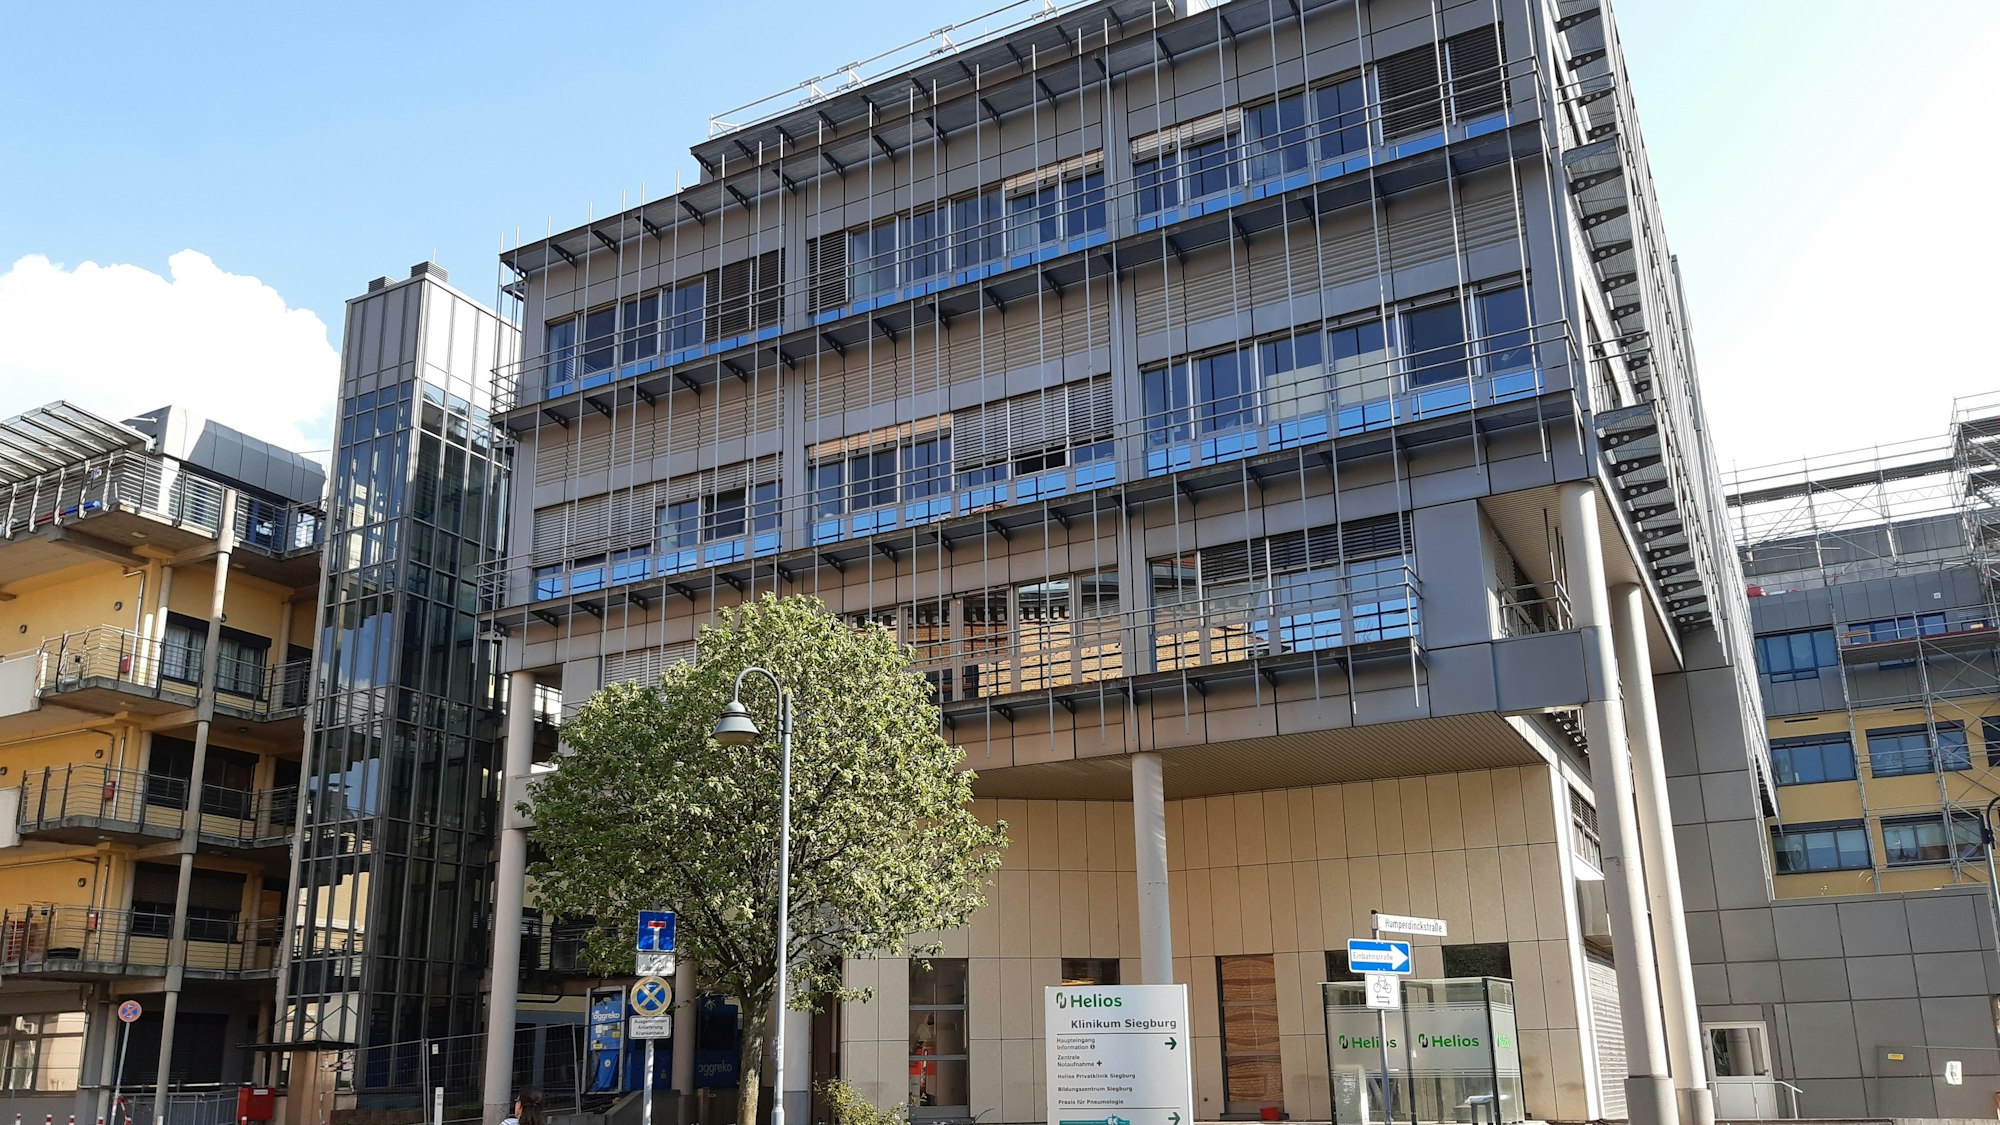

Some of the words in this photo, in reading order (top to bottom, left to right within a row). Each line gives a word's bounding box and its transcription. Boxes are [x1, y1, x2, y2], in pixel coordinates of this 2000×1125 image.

[1385, 918, 1443, 932] Humperdinckstraße
[1352, 952, 1393, 961] Einbahnstraße
[1070, 994, 1122, 1008] Helios
[593, 1011, 620, 1021] aggreko
[1071, 1019, 1121, 1029] Klinikum
[1124, 1018, 1177, 1030] Siegburg
[1352, 1035, 1397, 1048] Helis
[1432, 1034, 1480, 1048] Helios
[698, 1060, 733, 1076] aggreko
[1086, 1098, 1124, 1106] Pneumologie
